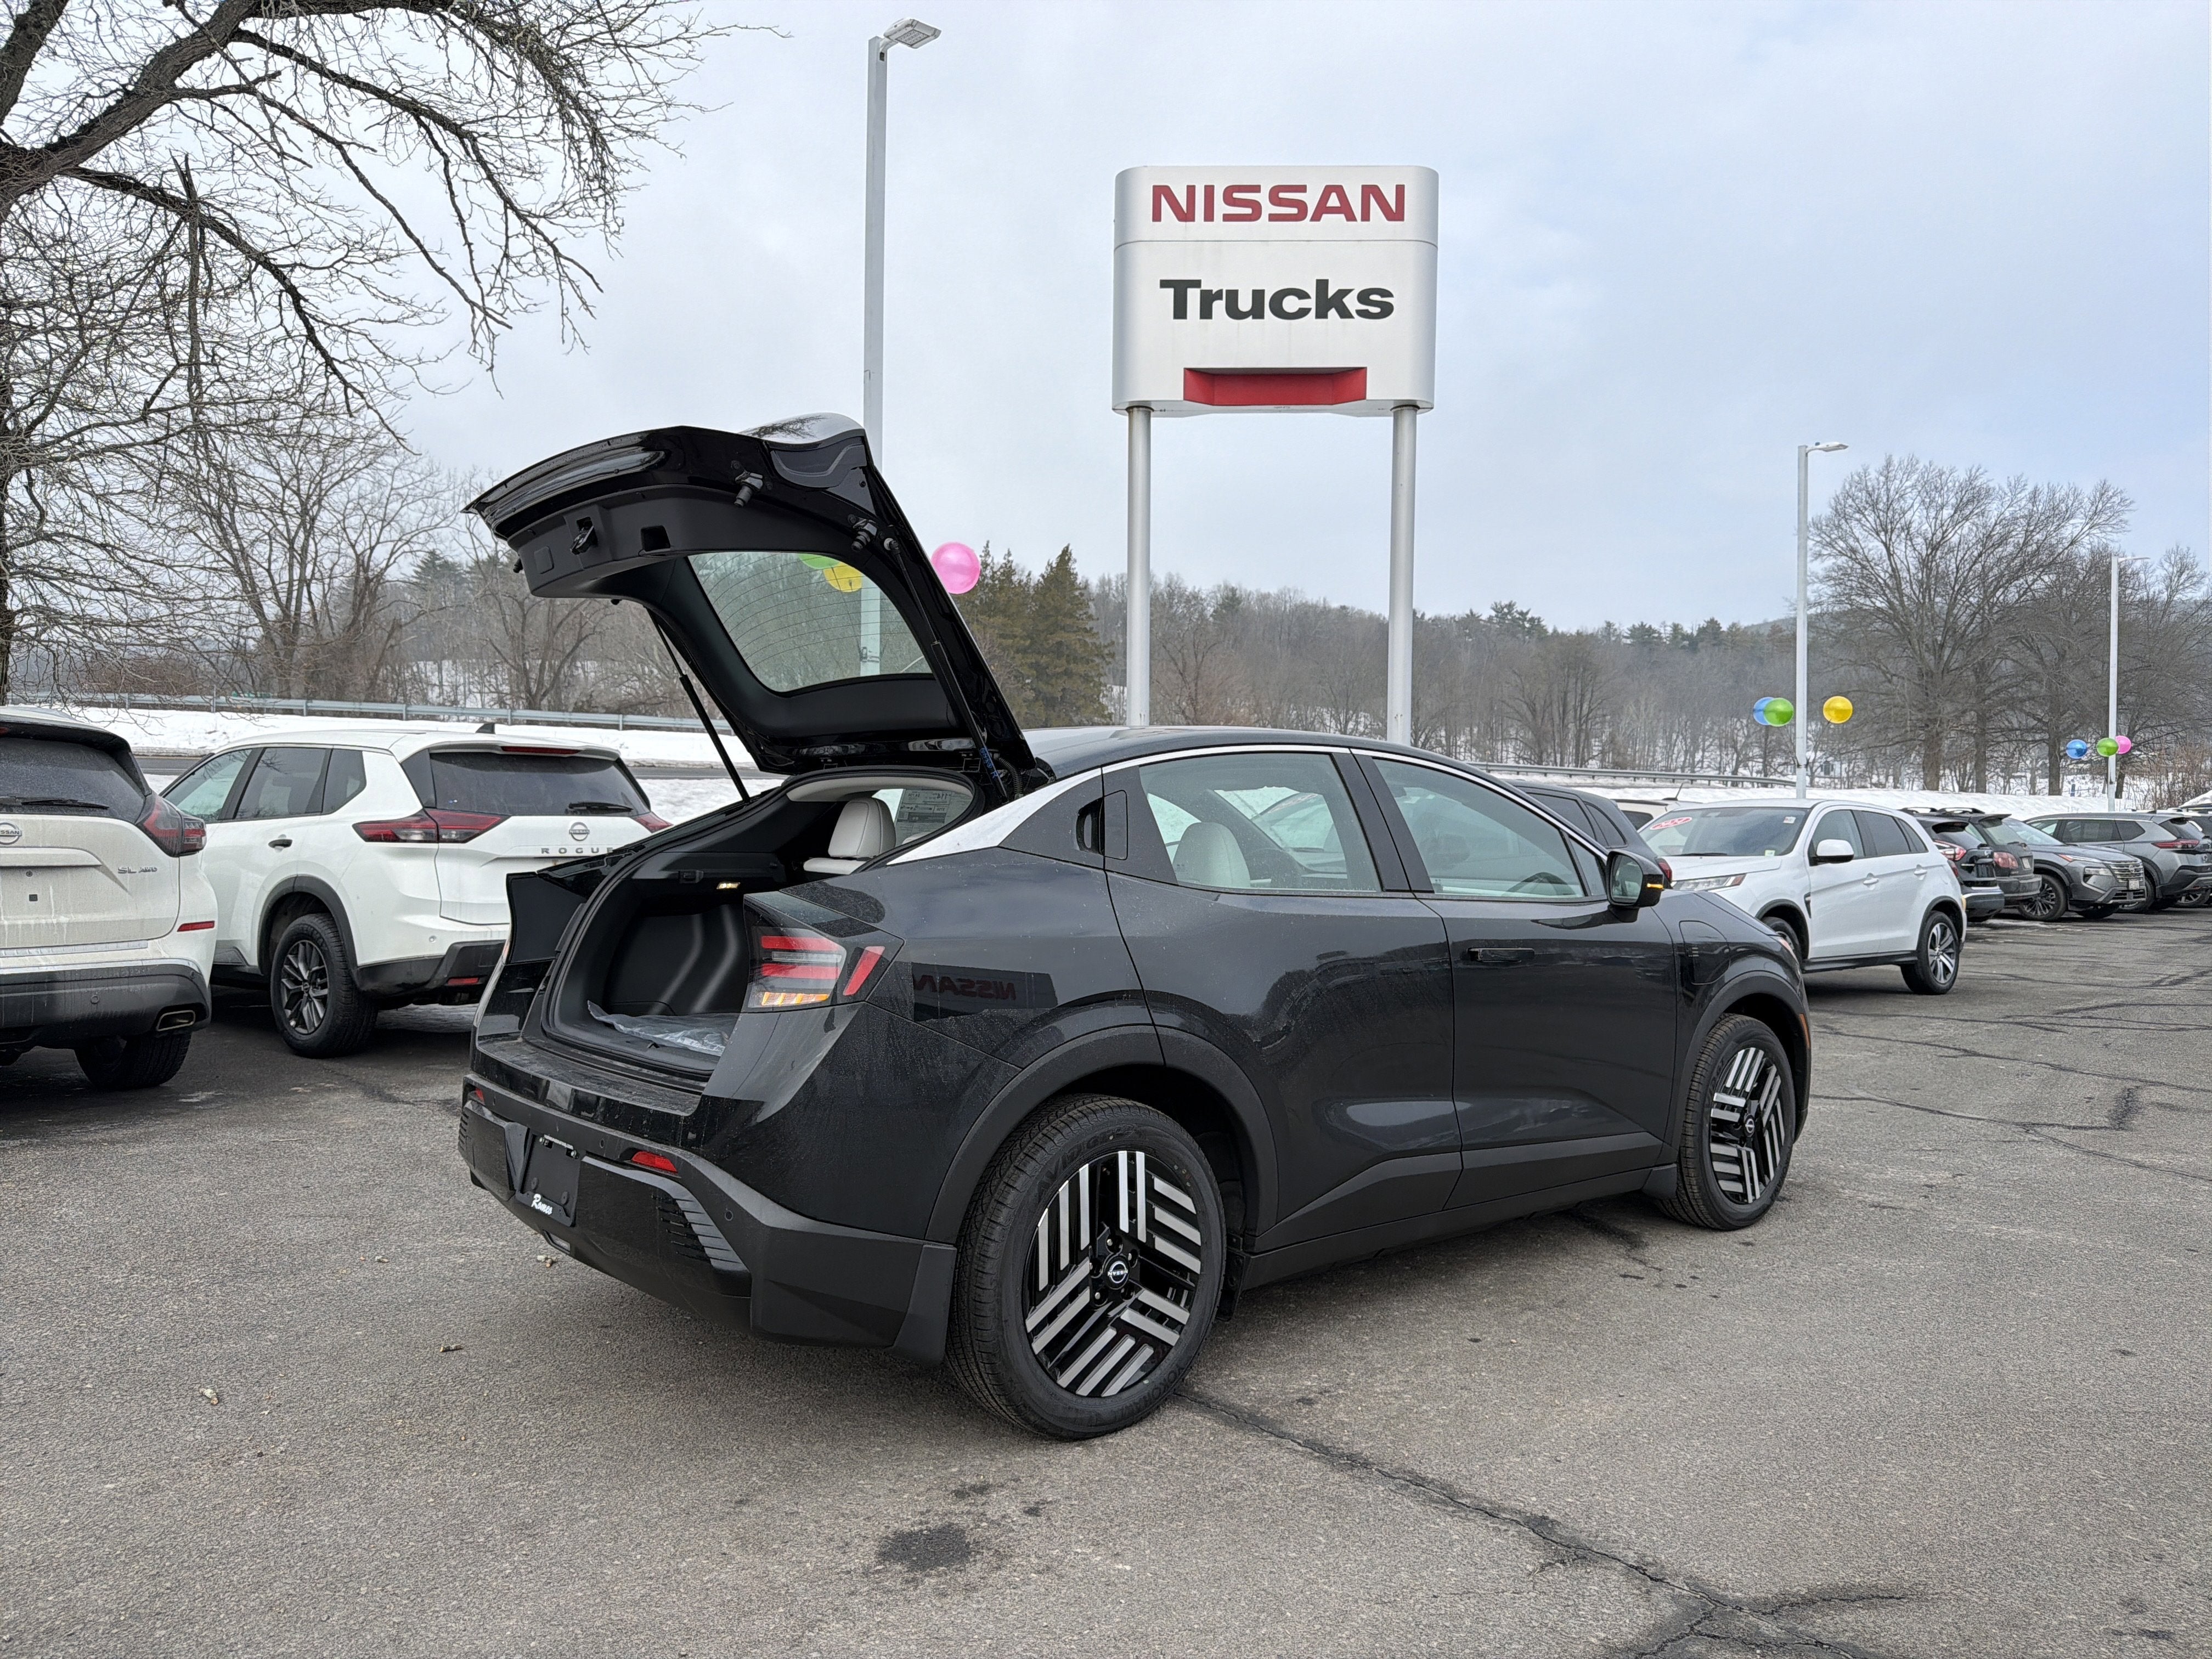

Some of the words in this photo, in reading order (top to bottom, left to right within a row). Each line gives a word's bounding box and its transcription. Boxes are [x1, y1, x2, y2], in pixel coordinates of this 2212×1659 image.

[1152, 184, 1406, 222] NISSAN
[1159, 279, 1394, 320] Trucks
[1107, 1268, 1128, 1277] NISSAN
